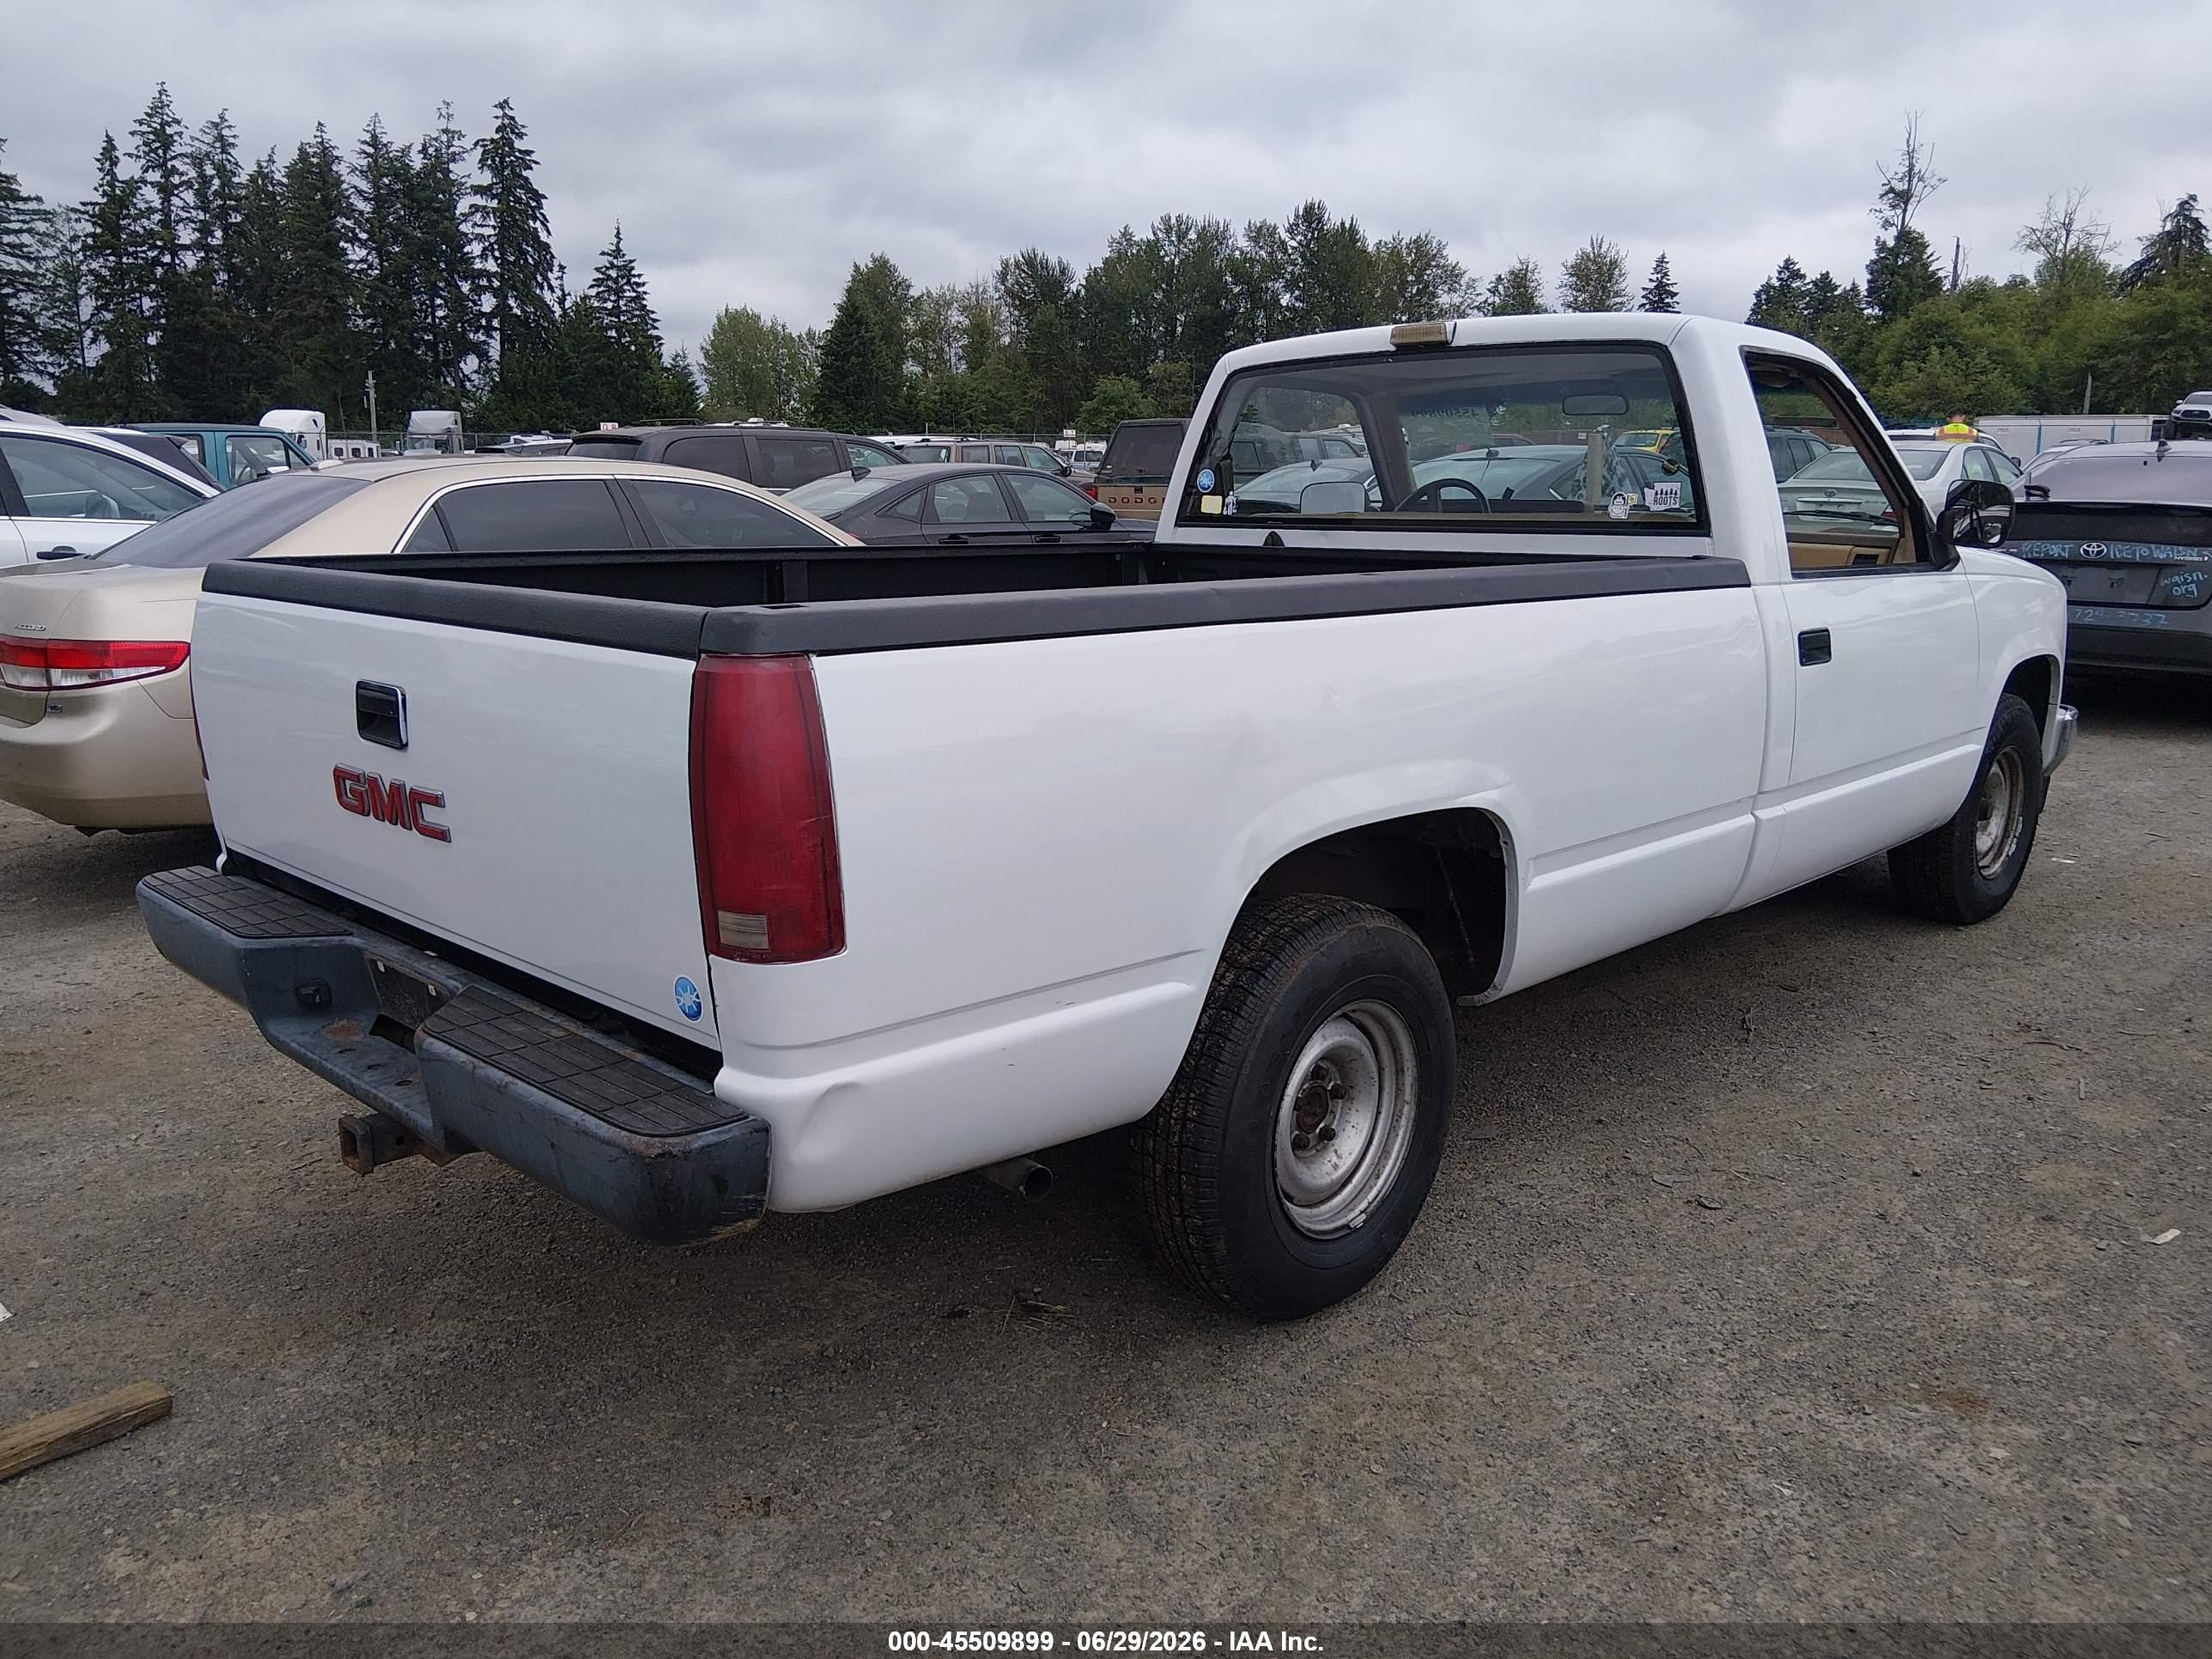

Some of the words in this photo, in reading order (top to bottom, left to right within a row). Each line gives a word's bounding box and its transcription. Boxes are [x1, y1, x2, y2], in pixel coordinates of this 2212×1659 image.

[1653, 496, 1677, 506] ROOTS
[2021, 543, 2074, 558] REPORT
[2172, 584, 2198, 599] org
[333, 763, 452, 842] GMC
